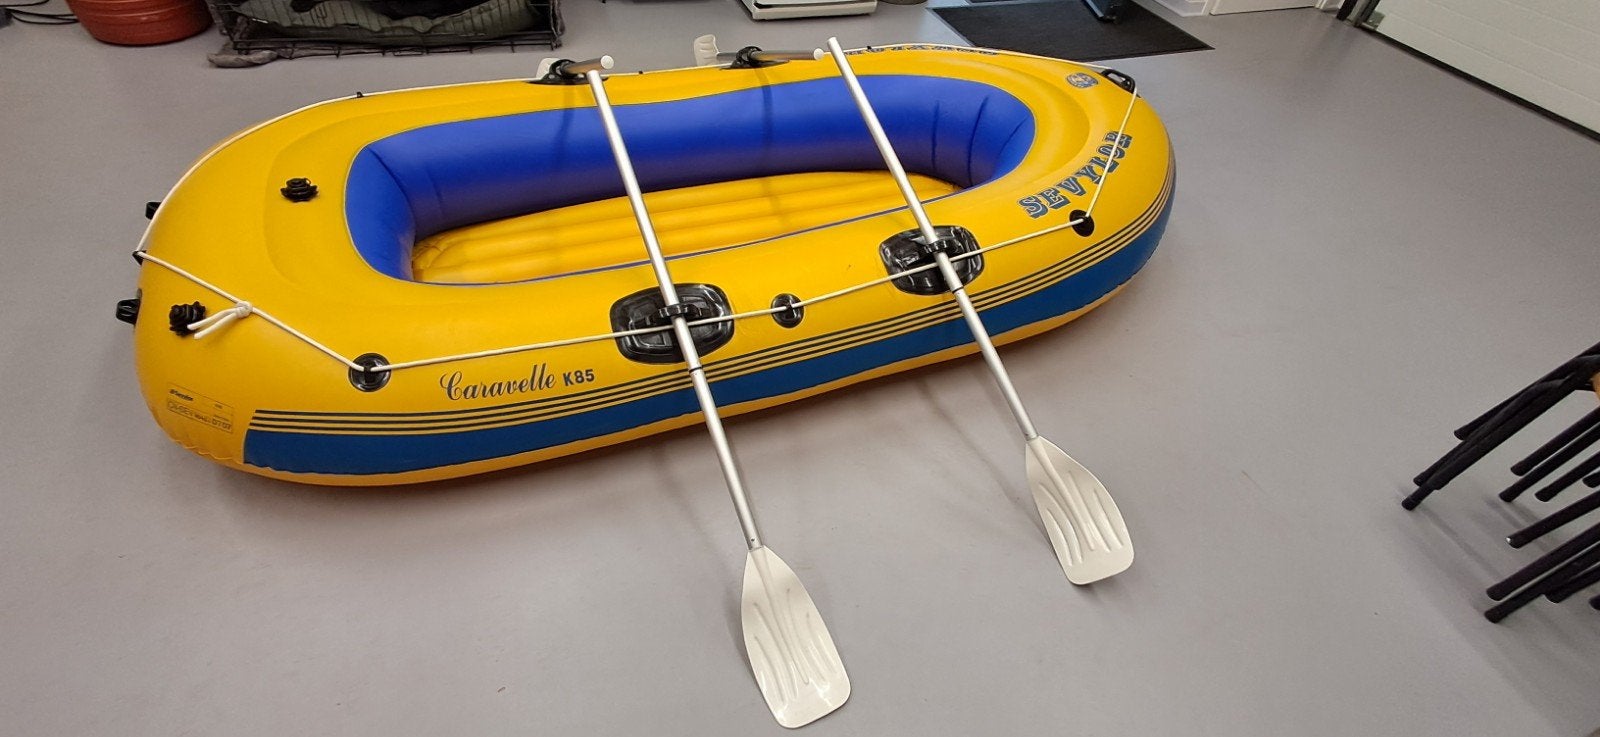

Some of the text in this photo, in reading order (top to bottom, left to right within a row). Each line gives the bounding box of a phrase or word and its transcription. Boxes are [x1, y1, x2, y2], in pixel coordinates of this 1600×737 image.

[1018, 131, 1133, 219] SEVYLOR
[439, 363, 595, 401] Caravelle K85
